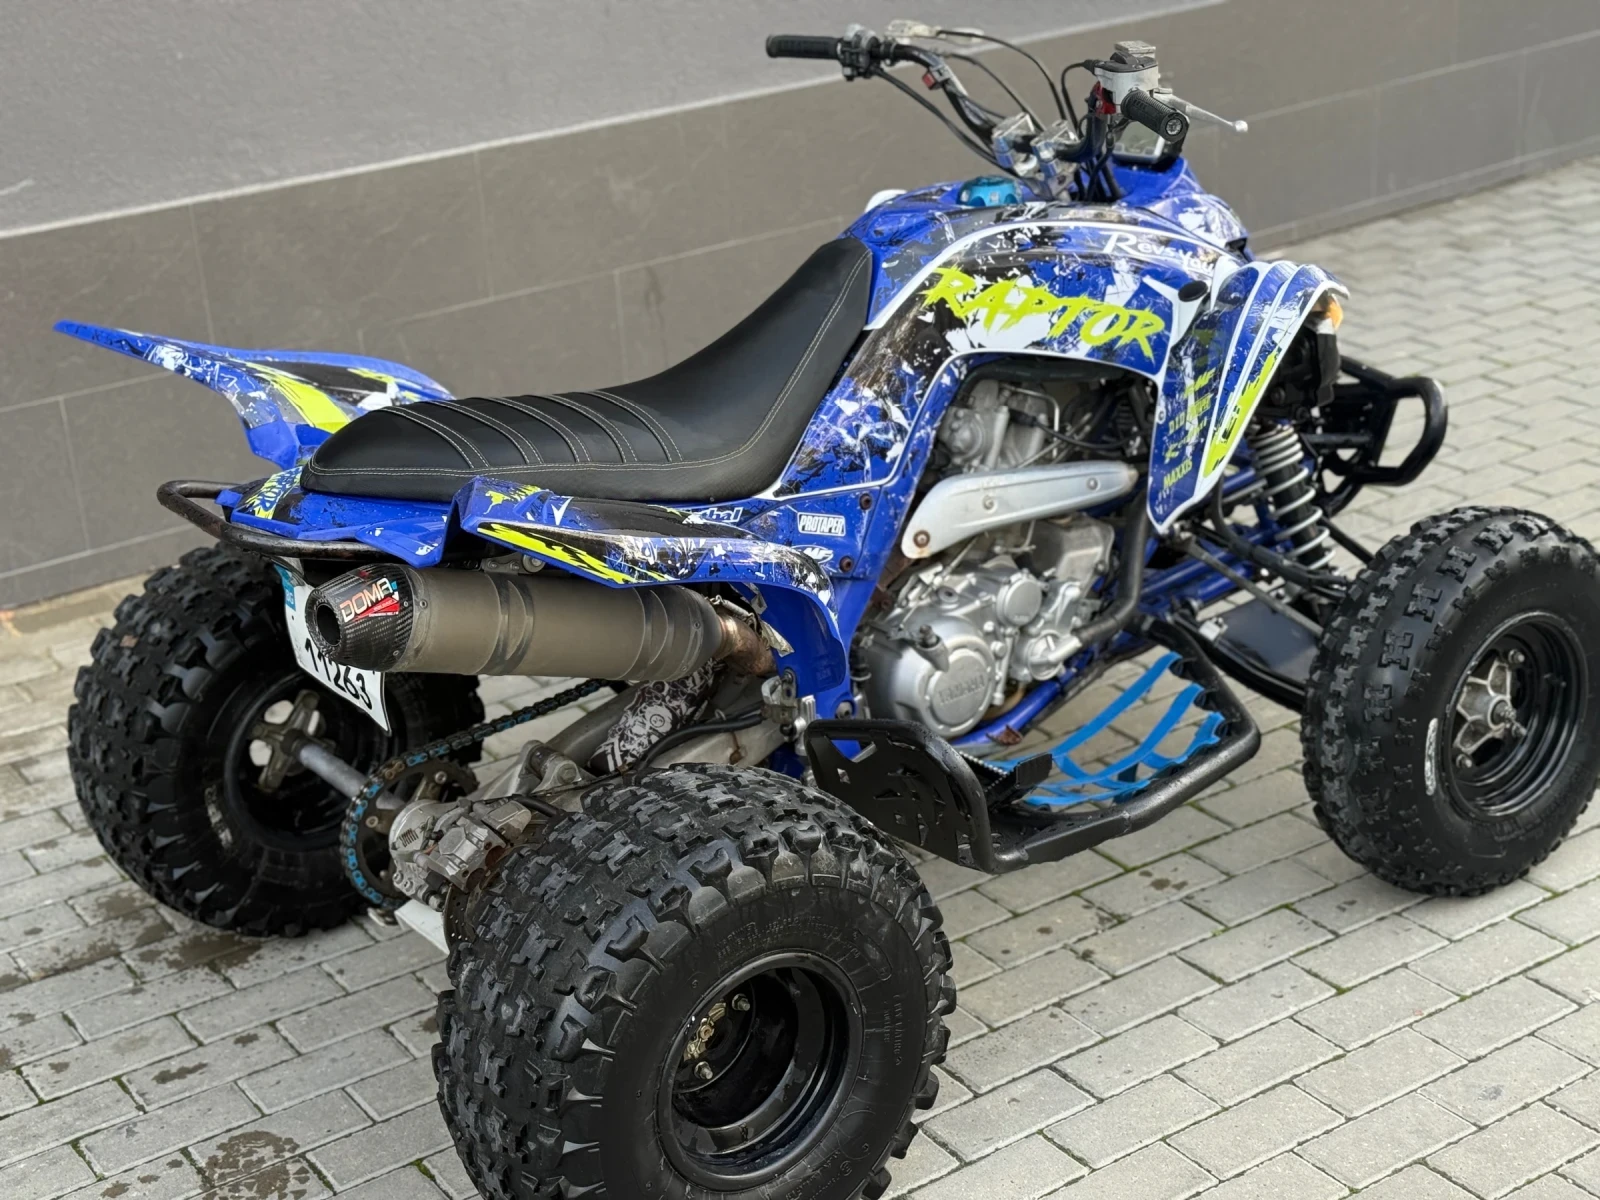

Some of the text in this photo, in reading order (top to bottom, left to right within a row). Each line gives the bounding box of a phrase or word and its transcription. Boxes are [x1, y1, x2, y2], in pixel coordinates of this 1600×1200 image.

[917, 264, 1166, 367] RAPTOR
[698, 506, 744, 523] hal
[800, 515, 844, 536] PROTAPER
[339, 577, 393, 623] DOMA
